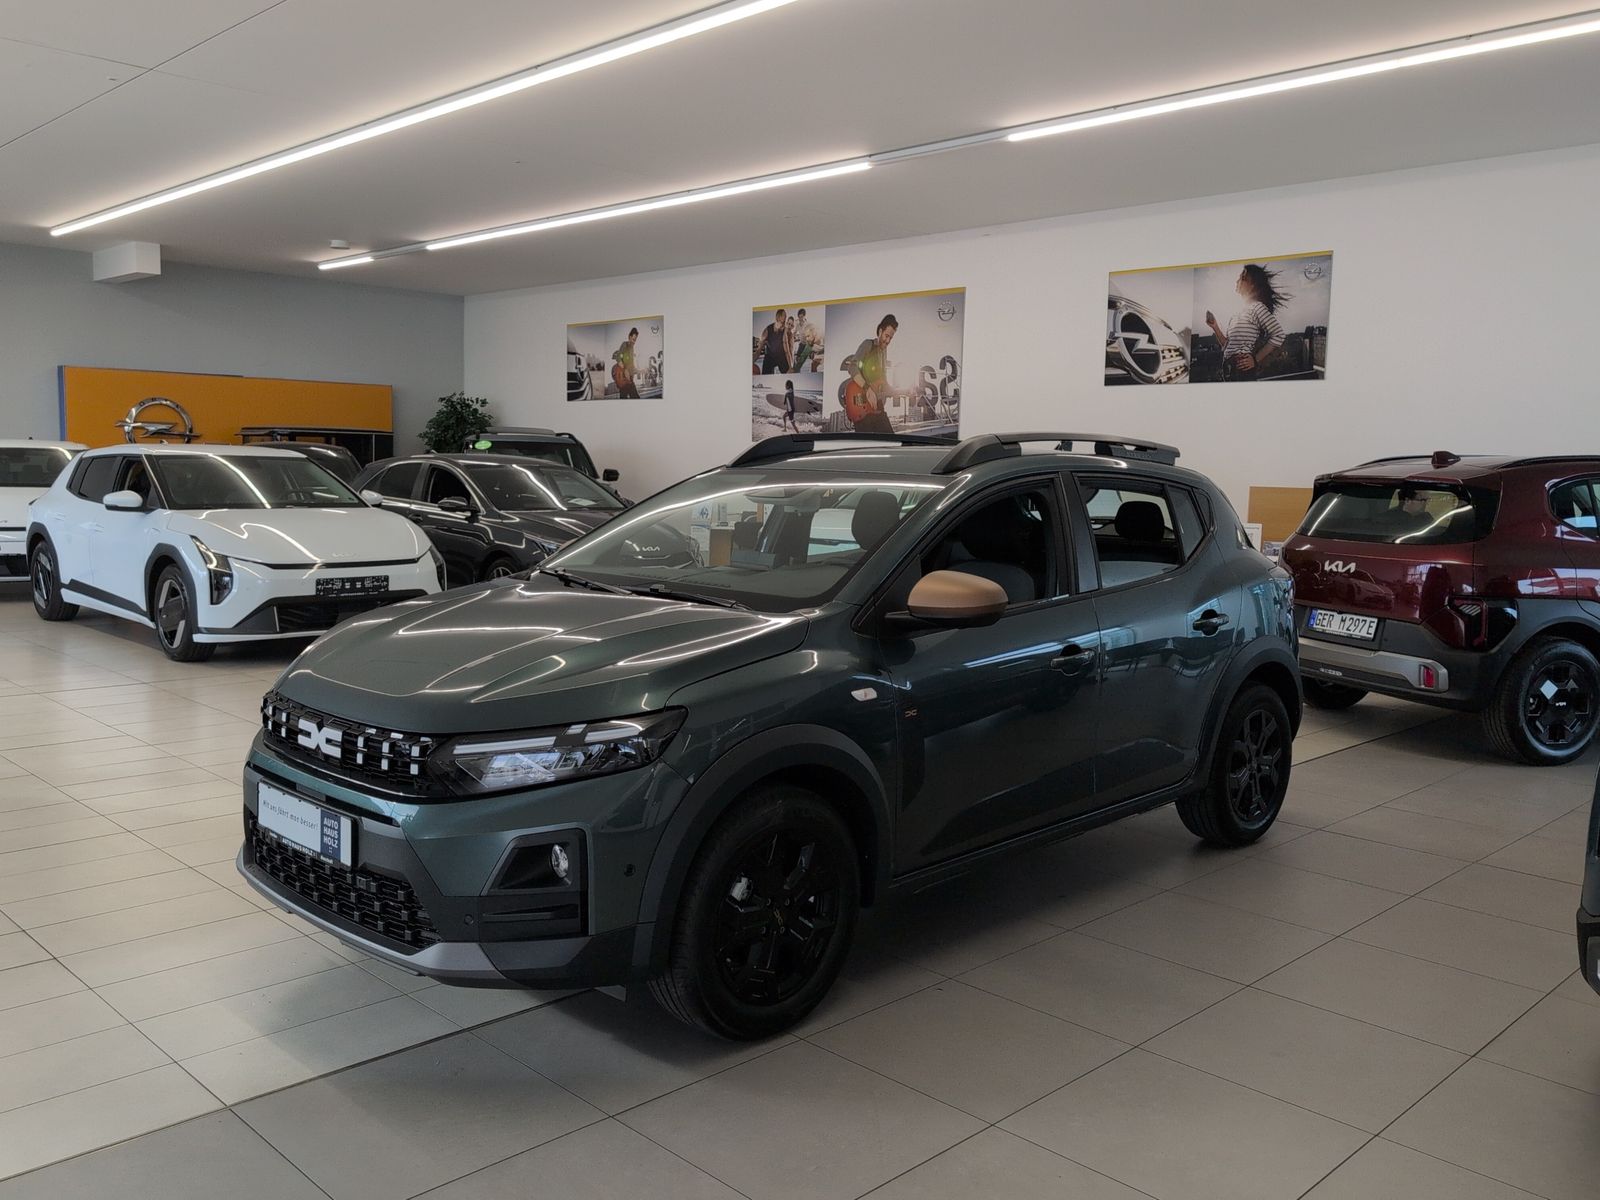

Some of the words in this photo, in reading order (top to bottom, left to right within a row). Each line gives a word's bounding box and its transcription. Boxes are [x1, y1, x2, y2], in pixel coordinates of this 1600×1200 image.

[1324, 559, 1356, 573] KIA
[1315, 612, 1334, 628] GER
[324, 817, 339, 830] AUTO
[324, 827, 339, 839] HAUS
[324, 835, 339, 849] HOLZ
